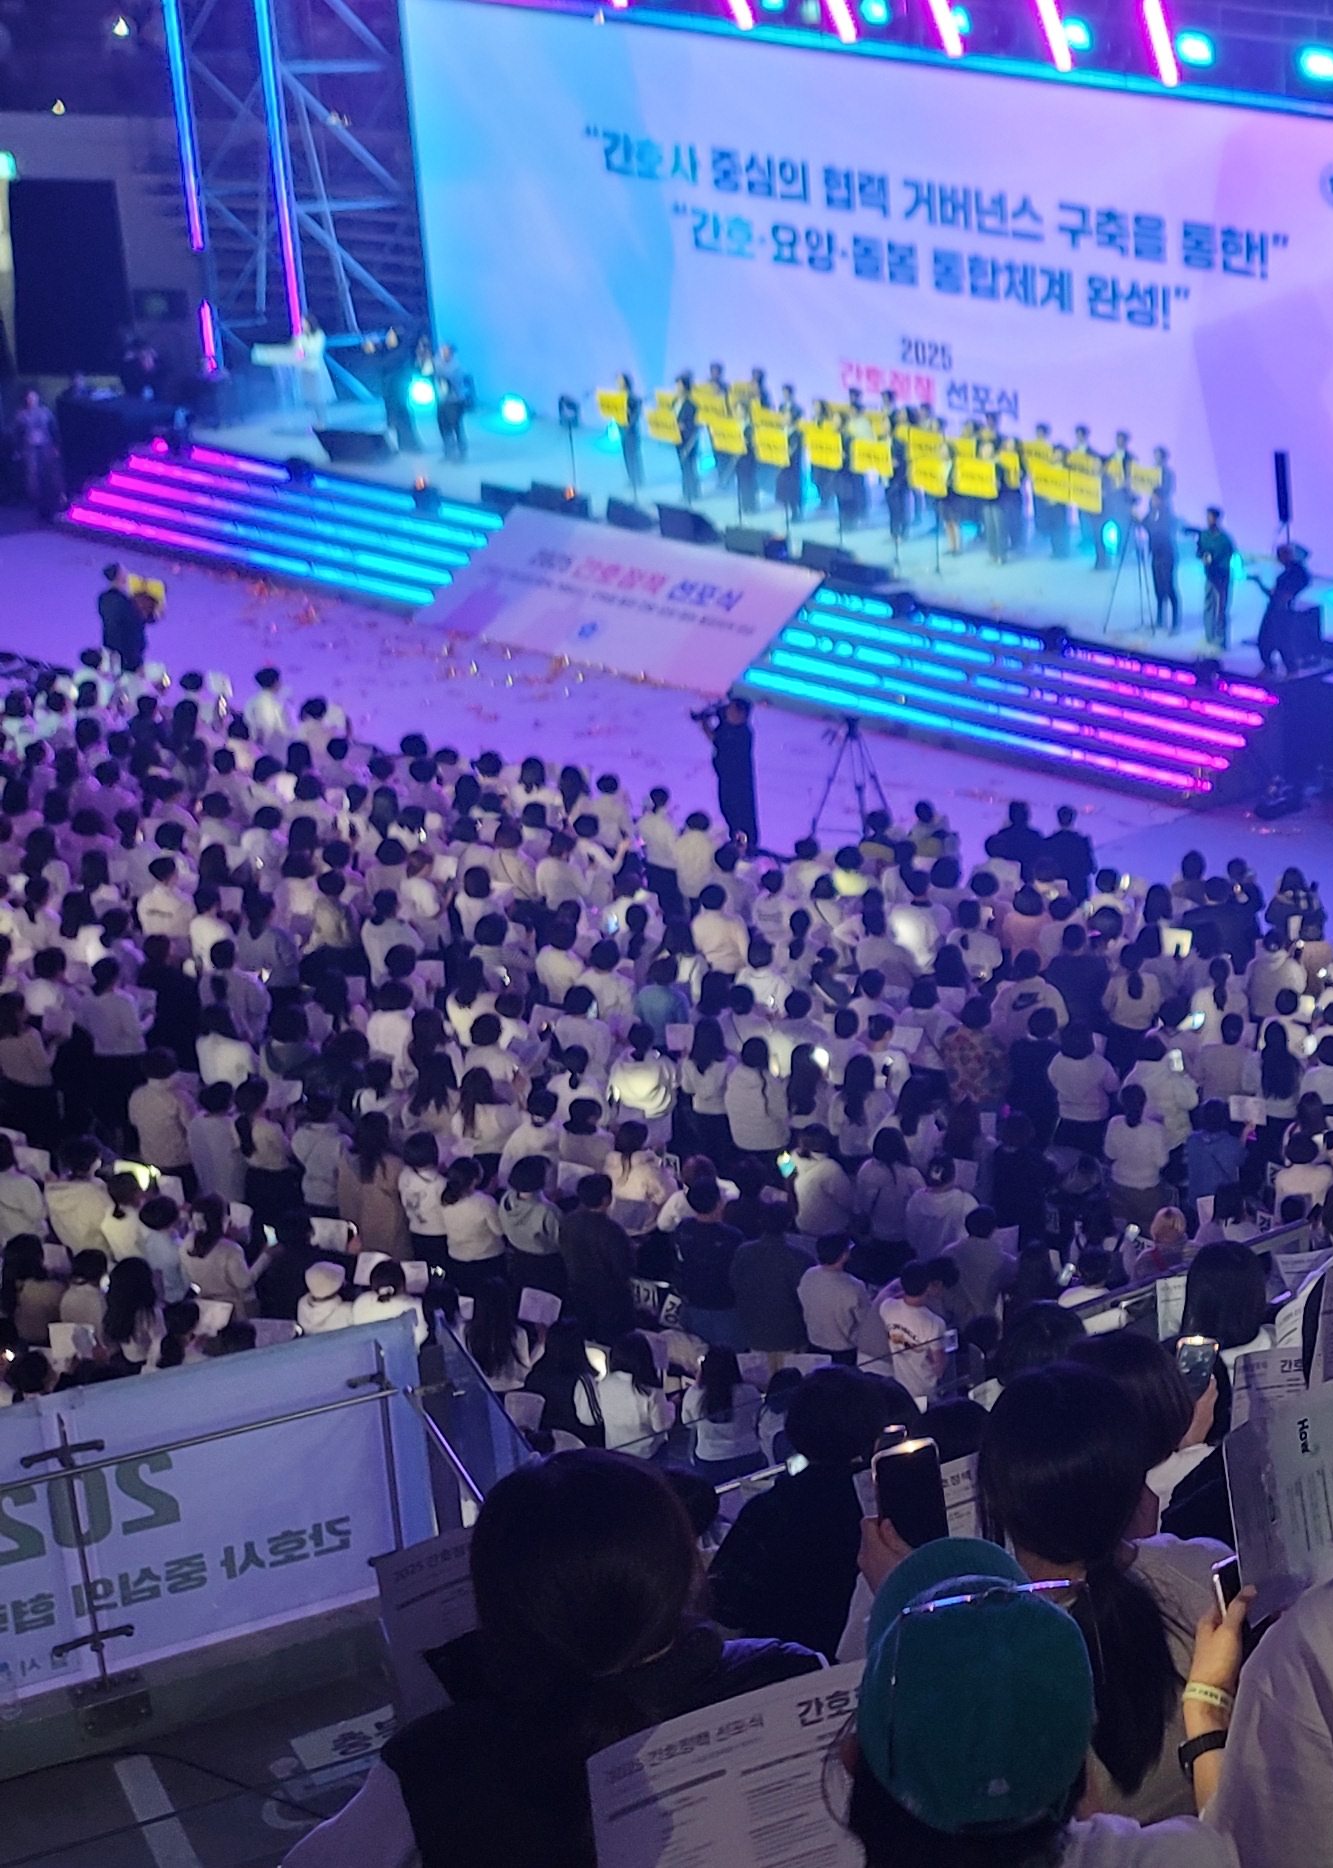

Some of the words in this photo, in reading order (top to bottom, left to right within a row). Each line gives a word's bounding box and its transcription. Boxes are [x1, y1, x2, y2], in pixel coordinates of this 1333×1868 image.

[711, 146, 810, 203] 중심의
[822, 164, 889, 219] 협력
[902, 178, 1044, 242] 거버넌스
[1057, 200, 1167, 264] 구축을
[932, 247, 1073, 314] 통합체계
[901, 336, 954, 371] 2025
[946, 379, 1019, 420] 선포식
[668, 579, 743, 612] 선포식
